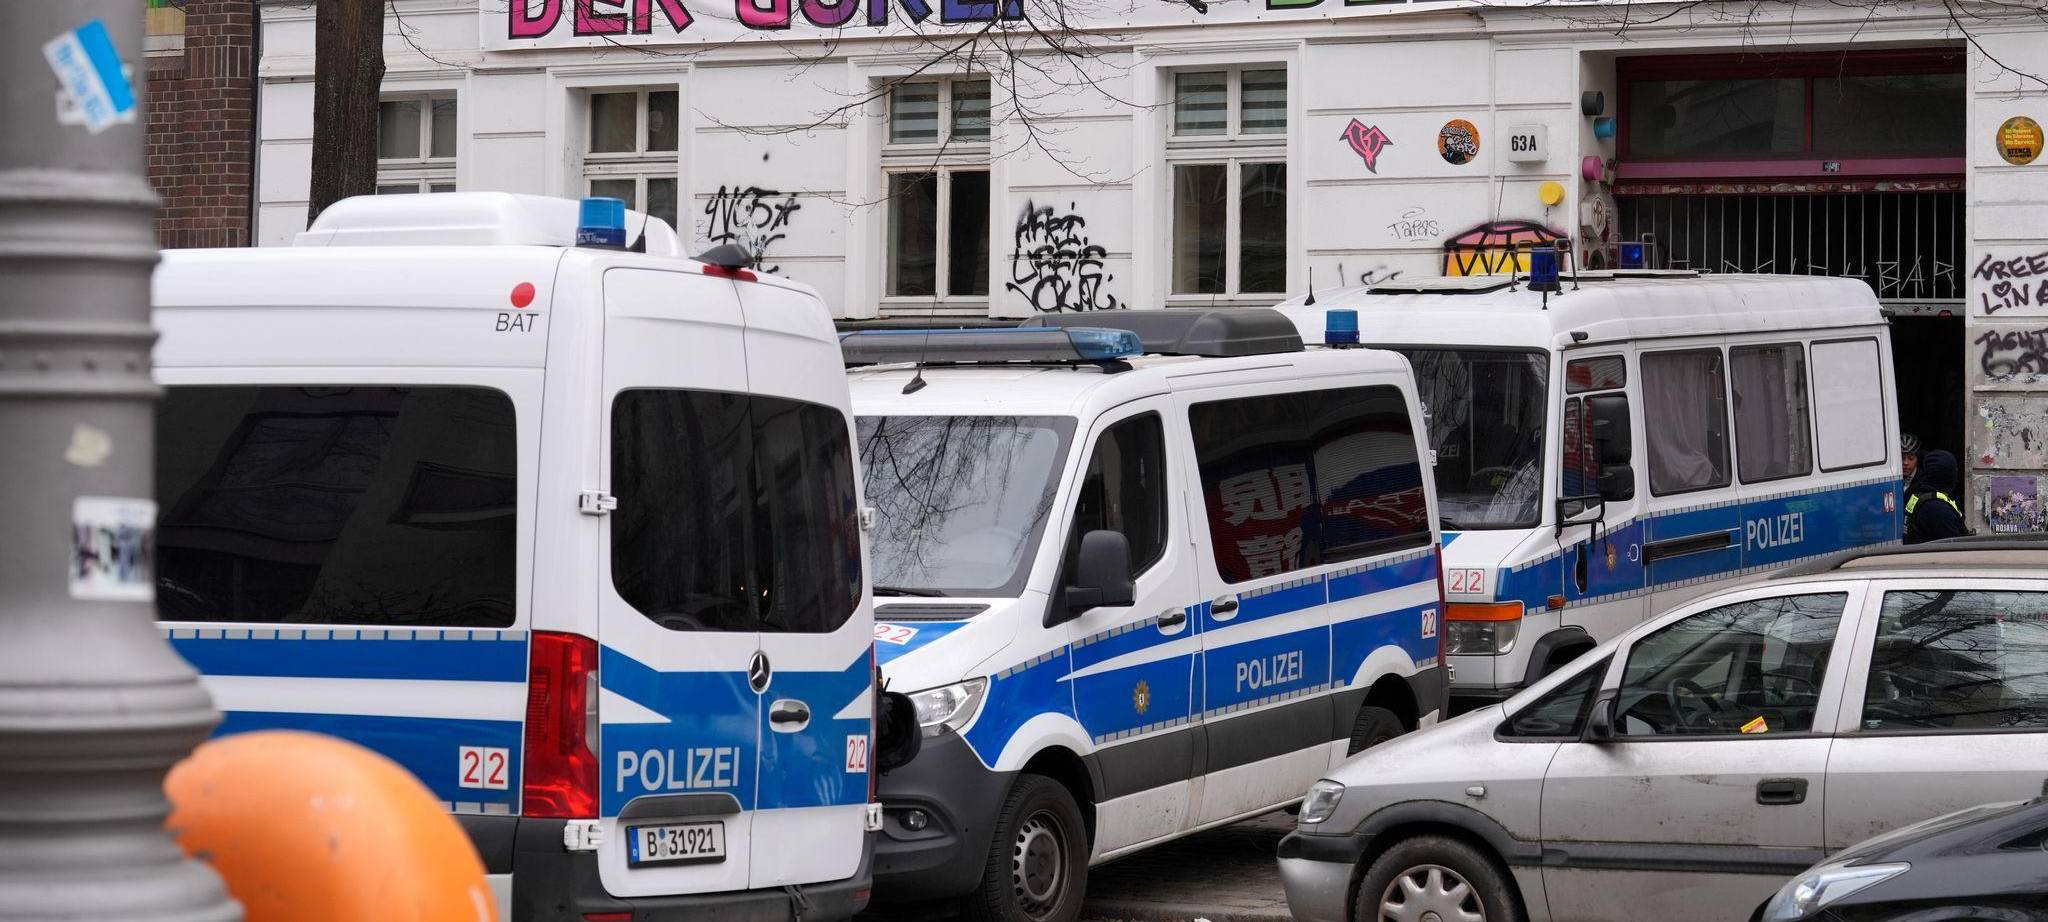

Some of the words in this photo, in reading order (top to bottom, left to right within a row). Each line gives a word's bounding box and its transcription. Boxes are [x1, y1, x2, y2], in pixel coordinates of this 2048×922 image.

[1511, 135, 1537, 152] 63A
[495, 312, 540, 332] BAT
[1746, 511, 1804, 551] POLIZEI
[1450, 571, 1481, 591] 22
[874, 625, 911, 643] 22
[1422, 612, 1435, 636] 22
[1236, 649, 1303, 693] POLIZEI
[464, 750, 505, 785] 22
[848, 739, 866, 769] 22
[616, 746, 741, 793] POLIZEI
[646, 831, 658, 857] B
[668, 827, 716, 855] 31921
